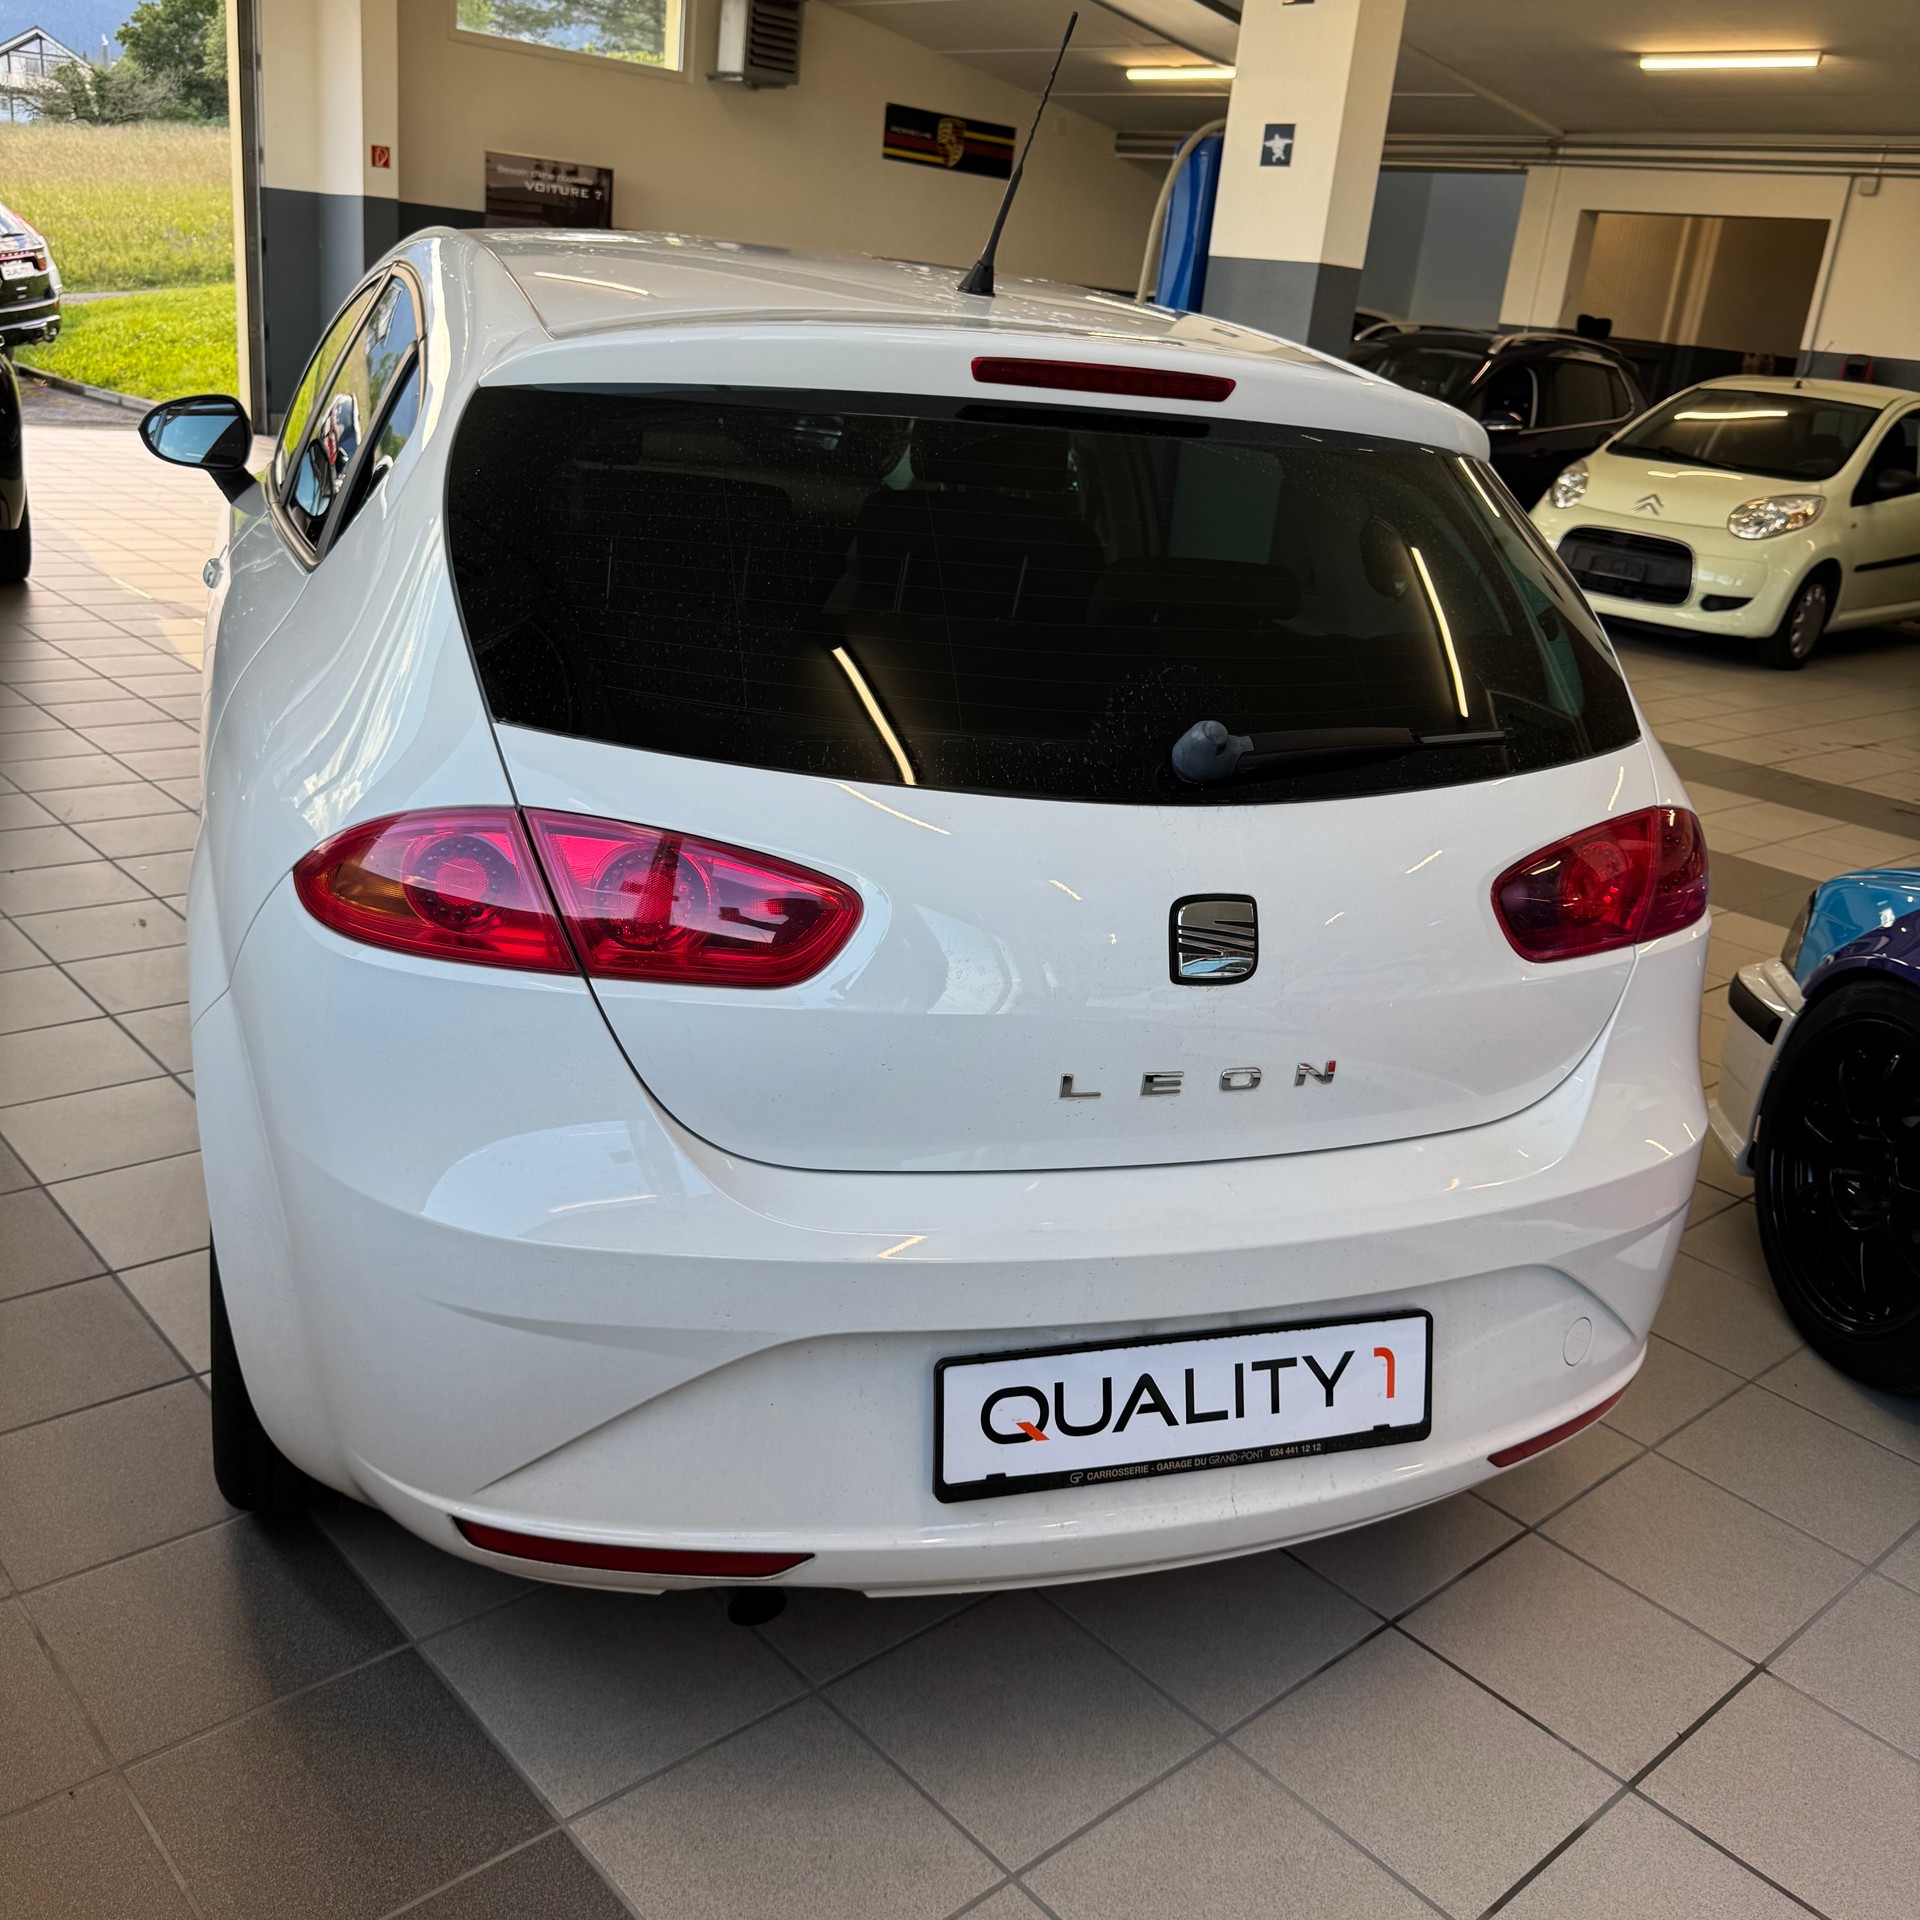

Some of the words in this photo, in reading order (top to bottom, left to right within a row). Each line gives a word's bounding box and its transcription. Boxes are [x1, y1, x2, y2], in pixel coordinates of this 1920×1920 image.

[524, 181, 590, 199] VOITURE
[595, 190, 603, 200] ?
[1059, 1060, 1337, 1099] LEON
[980, 1350, 1355, 1445] QUALITY
[1086, 1464, 1149, 1481] CARROSSERIE
[1156, 1458, 1193, 1472] GARAGE
[1194, 1457, 1207, 1467] DU
[1208, 1449, 1264, 1465] GRAND-PONT
[1269, 1448, 1284, 1457] 024
[1285, 1447, 1299, 1456] 441
[1301, 1445, 1311, 1453] 12
[1312, 1443, 1322, 1452] 12
